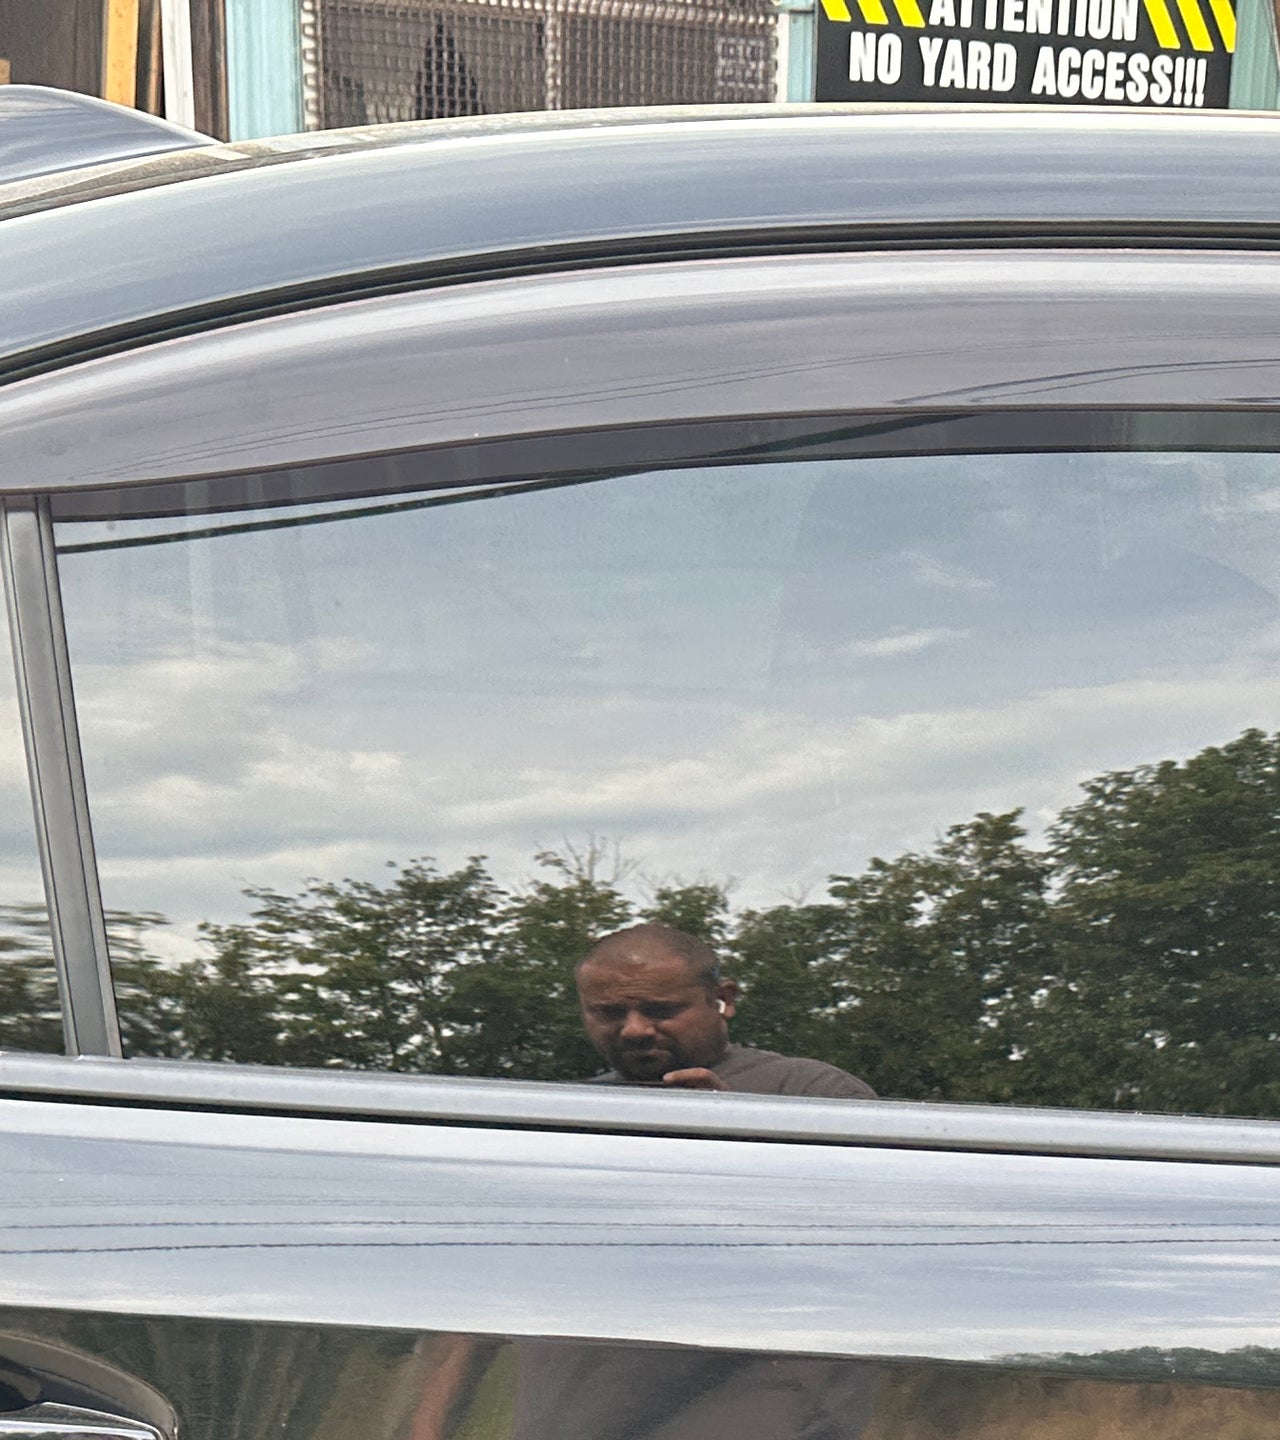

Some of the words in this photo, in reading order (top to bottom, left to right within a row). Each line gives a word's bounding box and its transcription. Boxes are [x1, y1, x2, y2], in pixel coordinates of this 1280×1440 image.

[928, 0, 1139, 41] ATTENTION
[849, 31, 902, 84] NO
[919, 36, 1018, 92] YARD
[1031, 48, 1208, 107] ACCESS!!!
